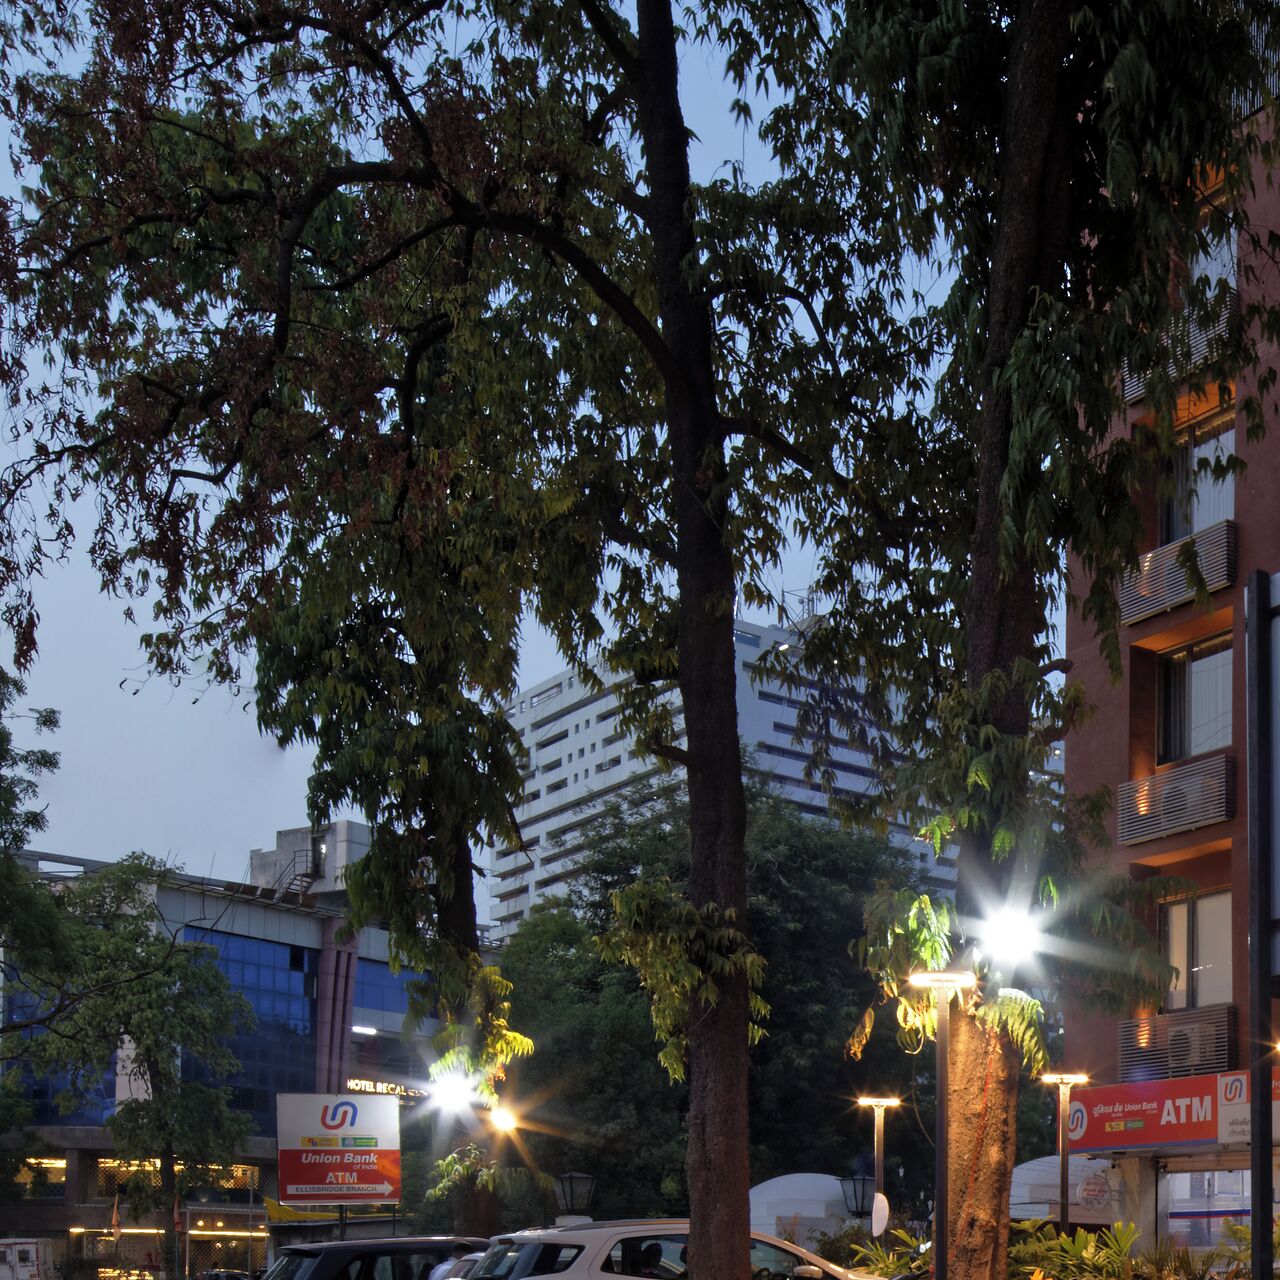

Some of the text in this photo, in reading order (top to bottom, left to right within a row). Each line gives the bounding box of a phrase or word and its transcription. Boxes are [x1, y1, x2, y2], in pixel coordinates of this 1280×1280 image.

[346, 1079, 375, 1092] HOTEL
[1124, 1103, 1142, 1111] Union
[1142, 1101, 1158, 1110] Bank
[1160, 1095, 1212, 1125] ATM
[301, 1152, 378, 1163] Union Bank
[325, 1172, 358, 1183] ATM
